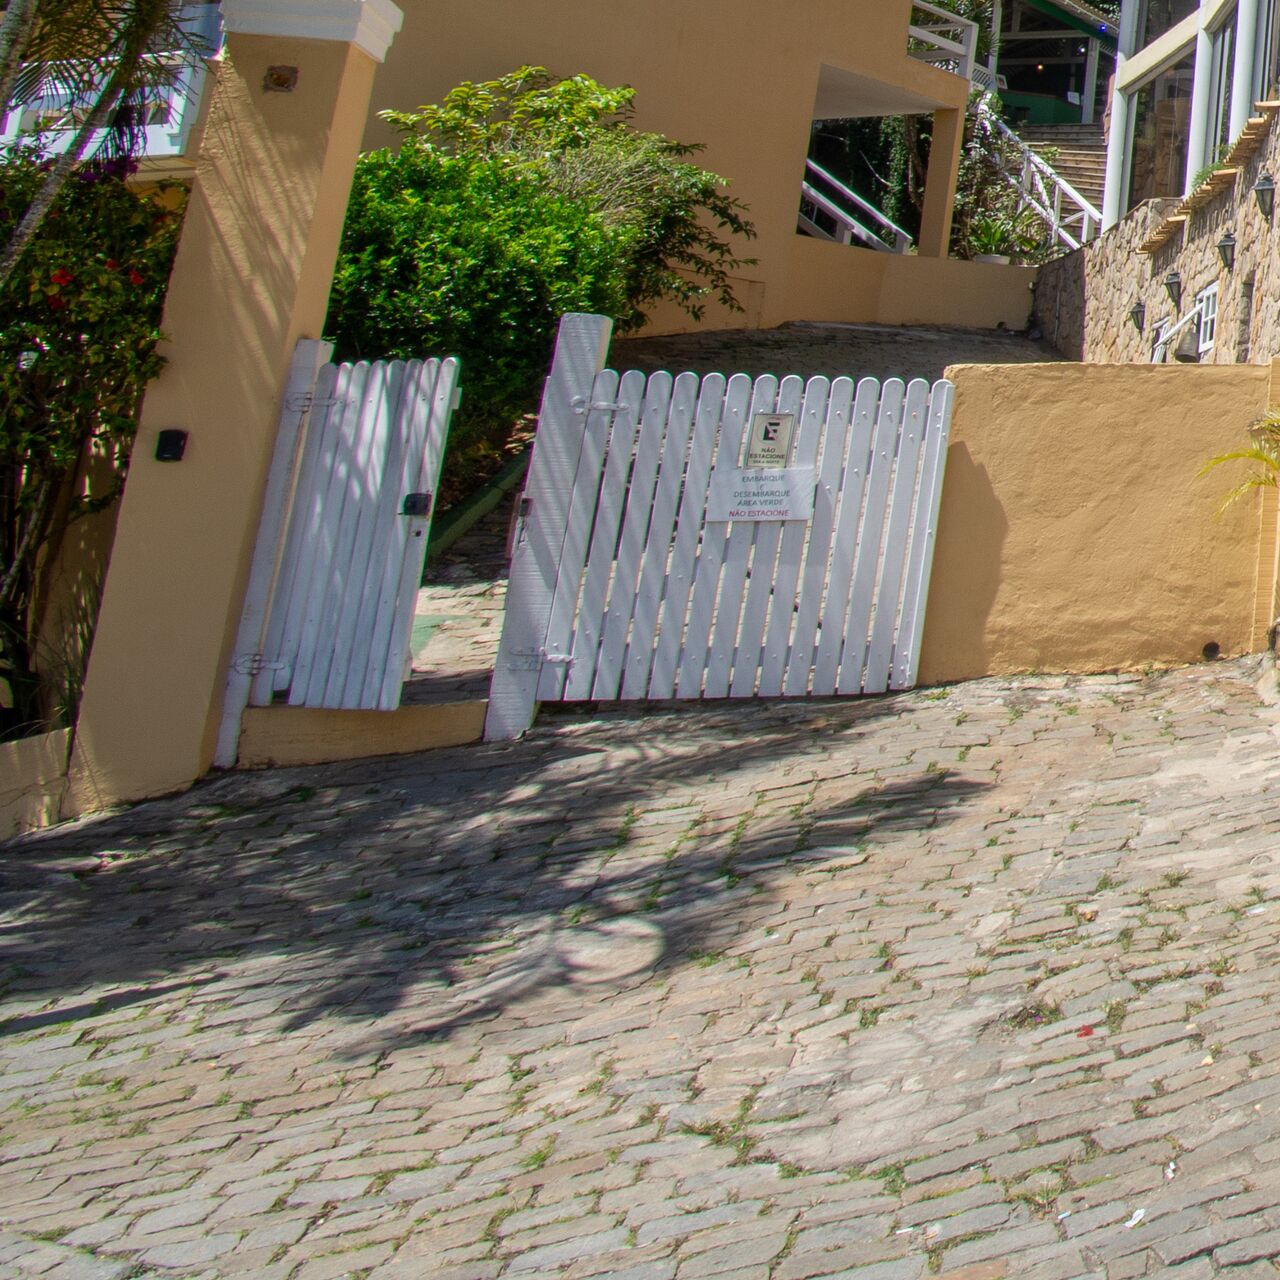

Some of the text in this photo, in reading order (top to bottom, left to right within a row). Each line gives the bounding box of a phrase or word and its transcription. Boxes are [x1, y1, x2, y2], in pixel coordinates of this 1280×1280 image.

[733, 490, 791, 498] DESEMBARQUE
[729, 509, 790, 517] NÃO ESTACIONE
